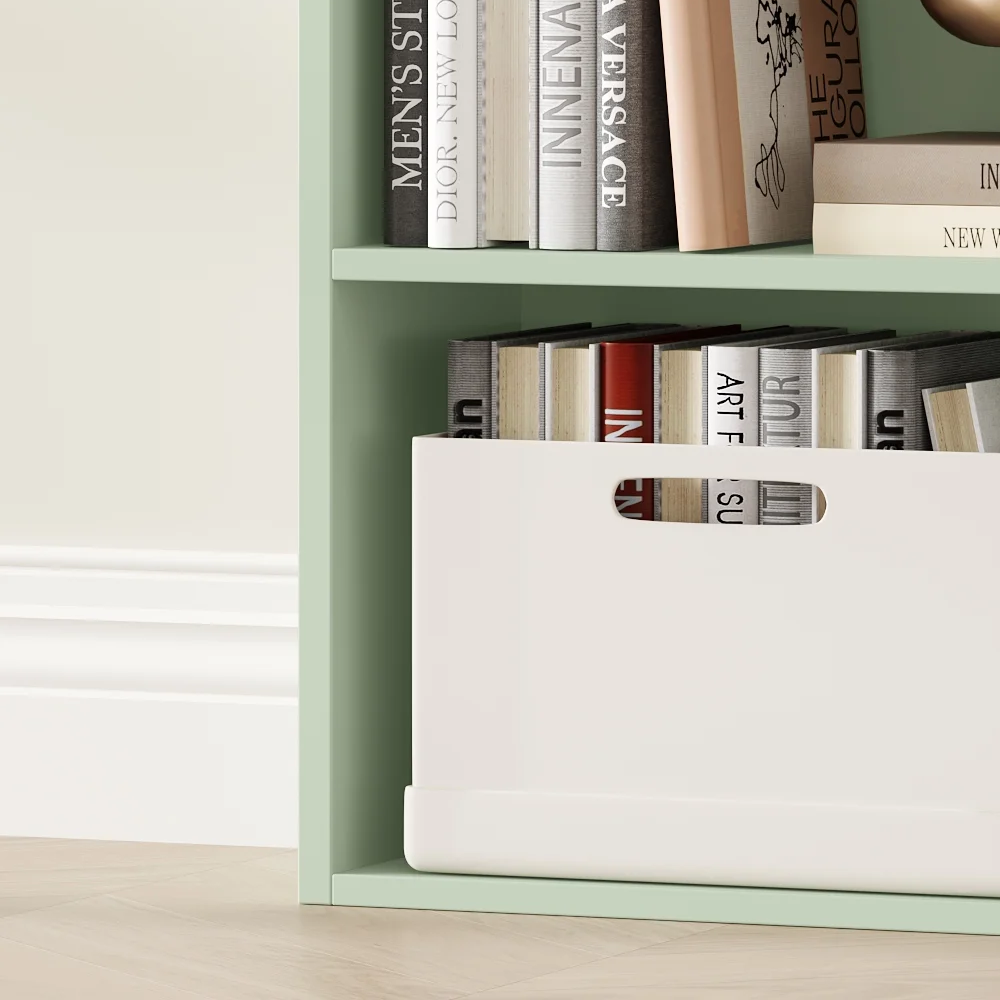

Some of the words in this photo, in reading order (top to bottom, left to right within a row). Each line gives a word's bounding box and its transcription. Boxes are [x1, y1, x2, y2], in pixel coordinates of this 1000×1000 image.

[436, 50, 459, 126] NEW
[601, 22, 627, 209] VERSACE
[809, 73, 830, 142] HE
[391, 64, 423, 191] MEN'S
[436, 136, 459, 223] DIOR.
[943, 226, 986, 250] NEW
[717, 372, 745, 420] ART
